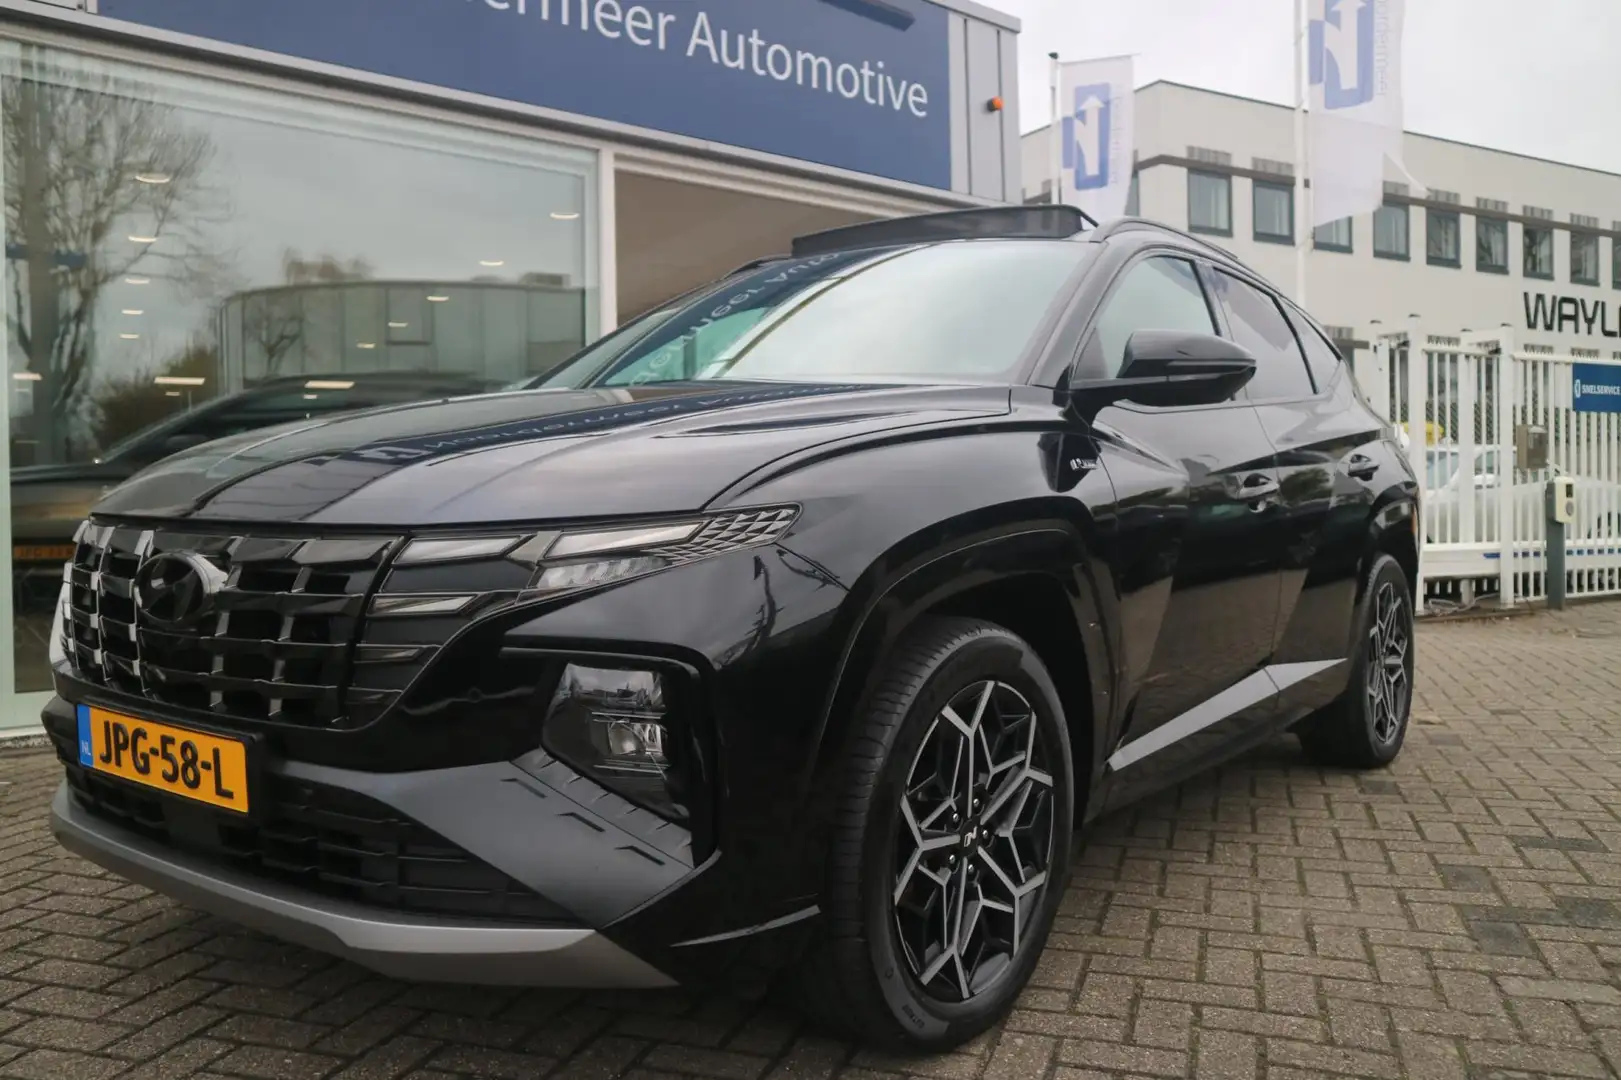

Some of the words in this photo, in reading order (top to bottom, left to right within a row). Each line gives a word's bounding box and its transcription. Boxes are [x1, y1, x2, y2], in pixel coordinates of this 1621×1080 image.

[483, 0, 676, 50] meer
[686, 11, 928, 117] Automotive
[1523, 291, 1621, 338] WAYL
[81, 740, 92, 756] NL
[100, 720, 234, 799] JPG-58-L
